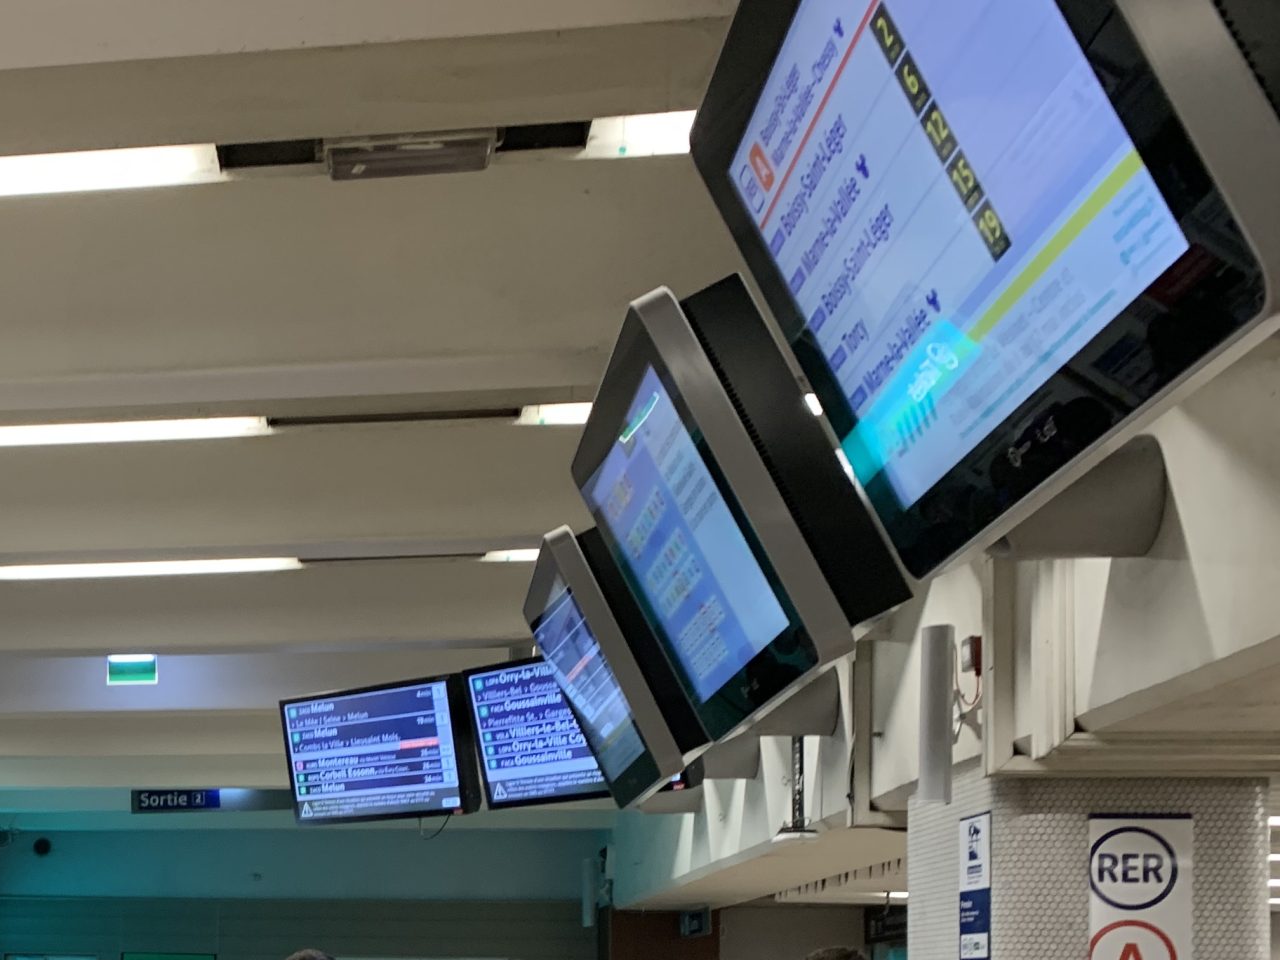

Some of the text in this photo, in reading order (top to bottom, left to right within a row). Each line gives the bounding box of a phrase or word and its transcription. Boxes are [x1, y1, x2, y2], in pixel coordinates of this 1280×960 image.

[876, 16, 895, 48] 2
[903, 63, 919, 95] 6
[926, 110, 949, 146] 12
[756, 155, 770, 183] A
[780, 113, 847, 237] Boissy-Saint-Léger
[952, 158, 975, 195] 15
[801, 176, 861, 276] Marne-la-Vallée
[979, 209, 1001, 244] 19
[821, 203, 894, 316] Boissy-Saint-Léger
[841, 318, 870, 355] Torcy
[863, 307, 931, 395] Marne-la-Vallée
[311, 702, 334, 714] Melun
[504, 693, 562, 711] Goussainville
[314, 727, 337, 738] Melun
[511, 735, 568, 753] Orry-la-Ville
[318, 756, 359, 768] Montereau
[514, 749, 572, 767] Goussainville
[141, 791, 188, 808] Sortie
[322, 782, 345, 793] Melun
[1097, 852, 1164, 884] RER
